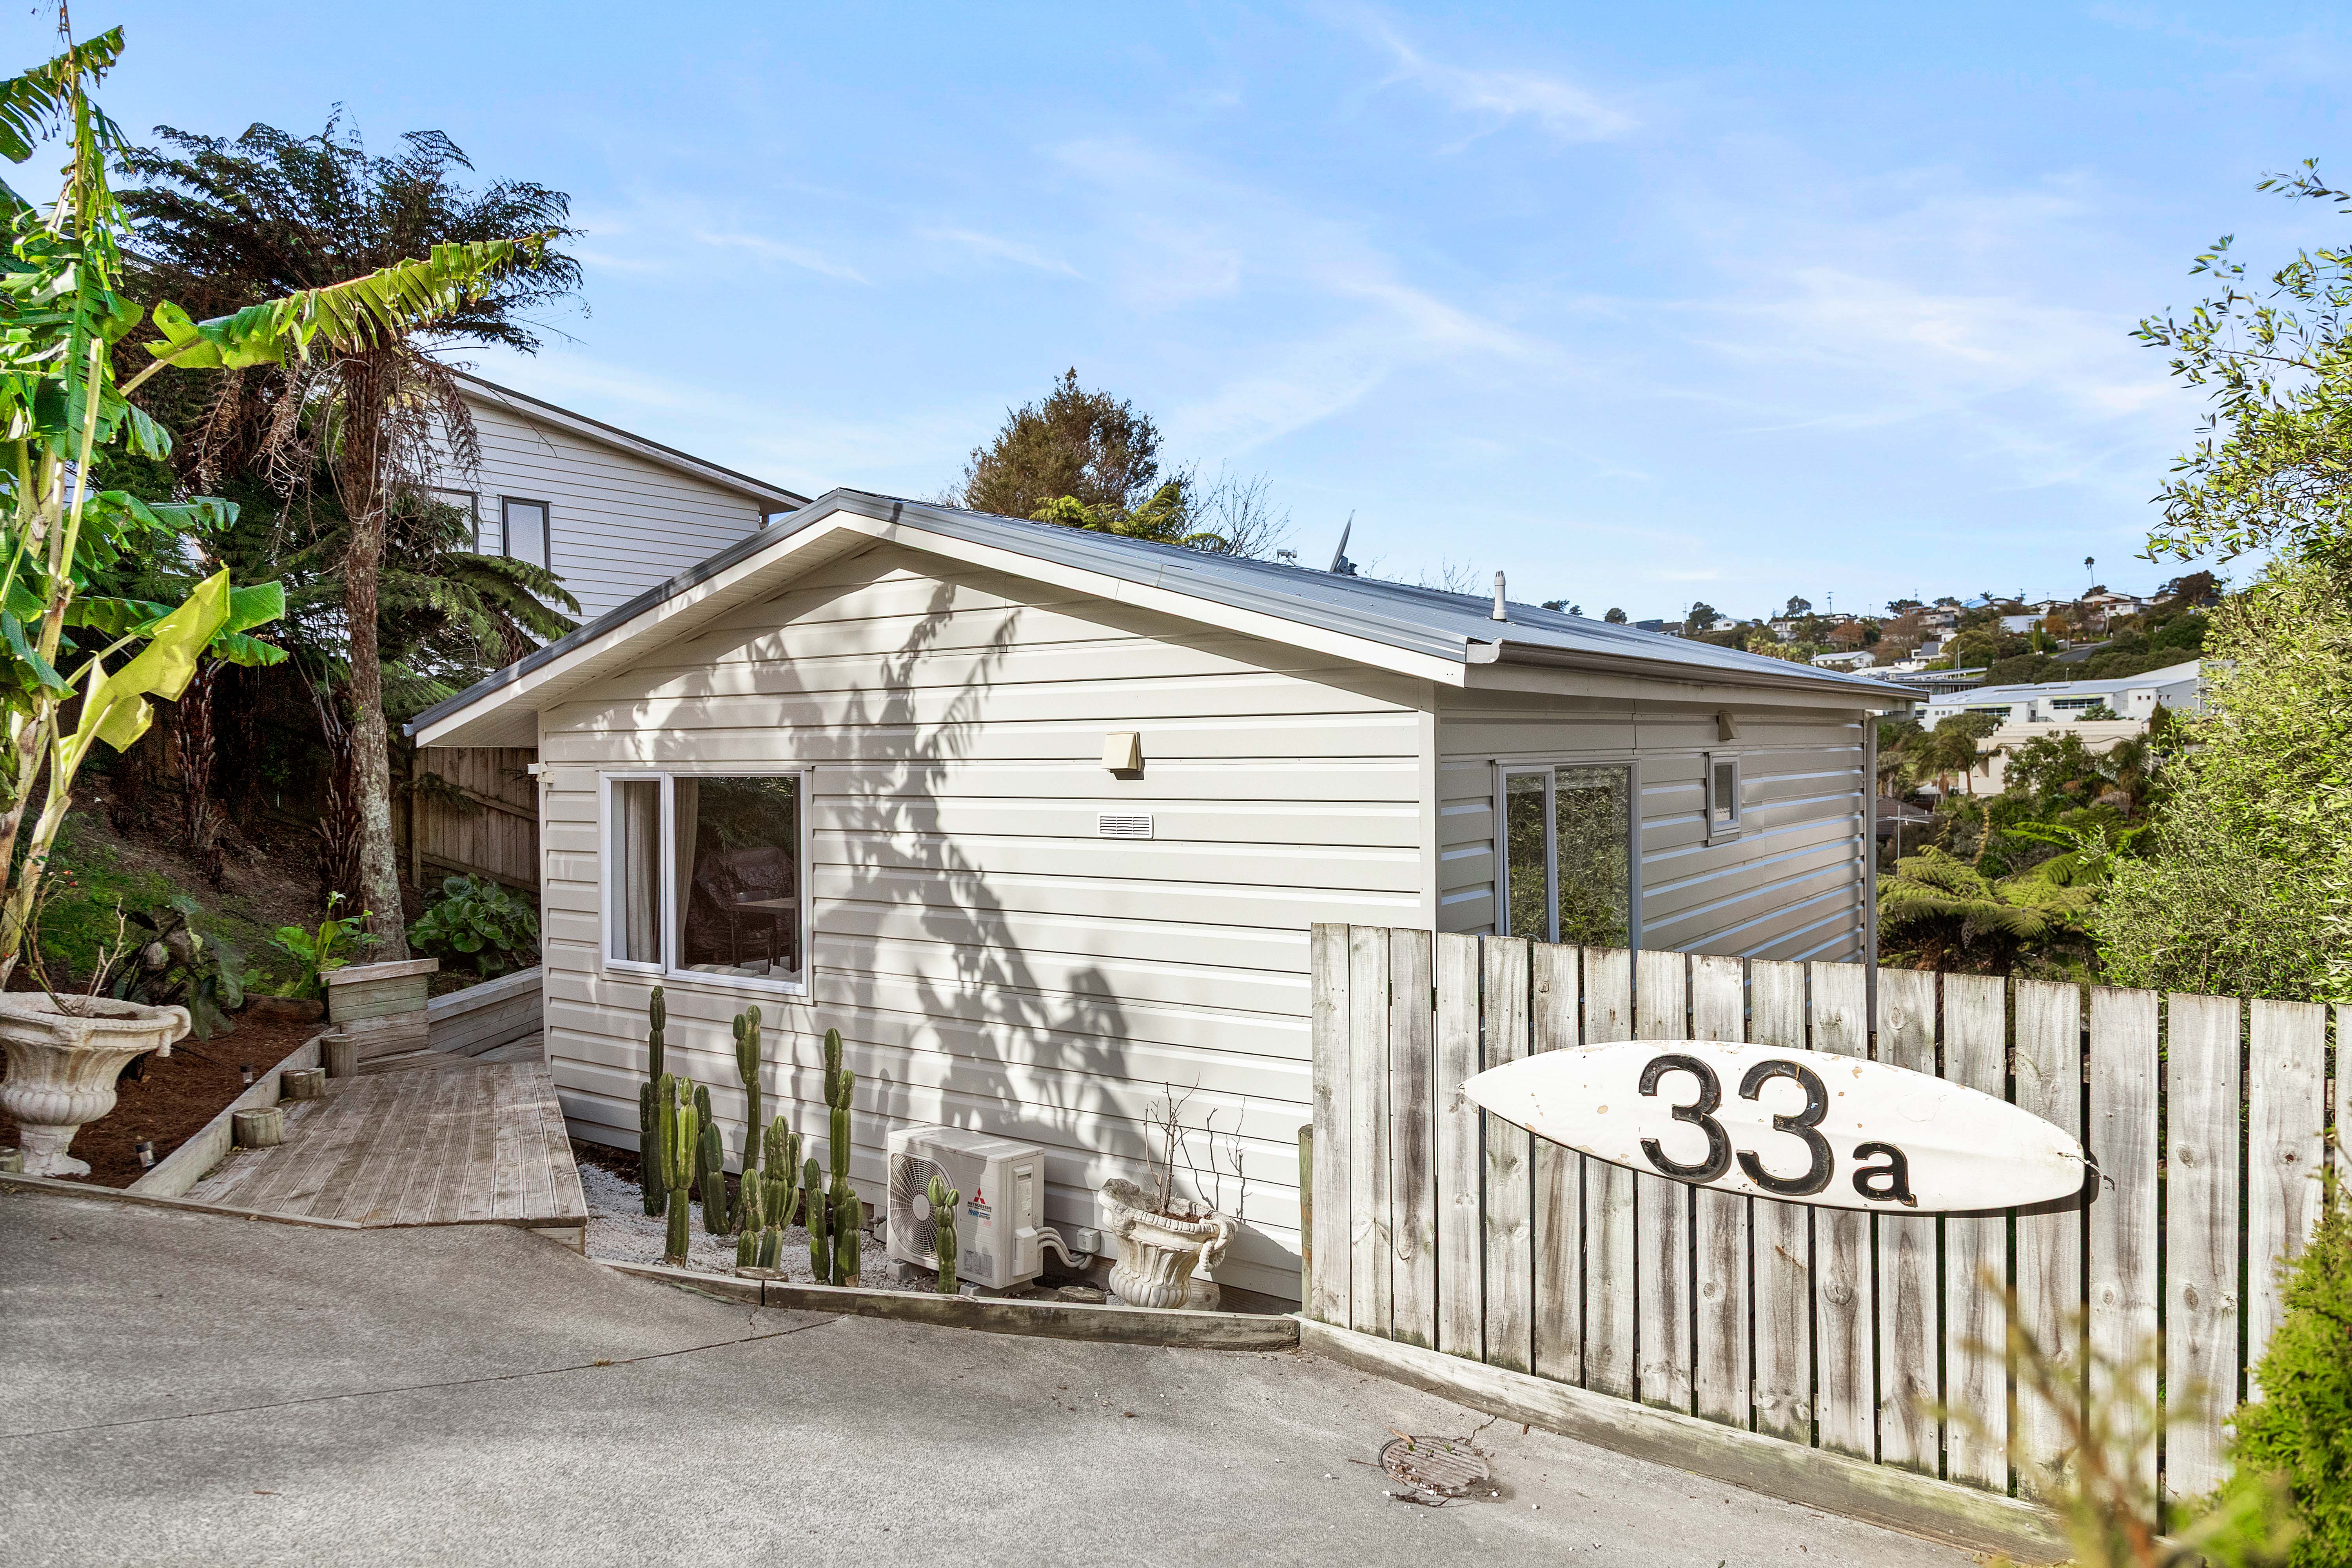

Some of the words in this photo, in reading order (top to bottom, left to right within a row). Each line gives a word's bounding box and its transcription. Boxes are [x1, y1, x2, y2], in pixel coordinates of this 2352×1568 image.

[1639, 1054, 1918, 1208] 33a
[967, 1201, 991, 1210] MITSUBISHI
[968, 1208, 980, 1217] Hyper
